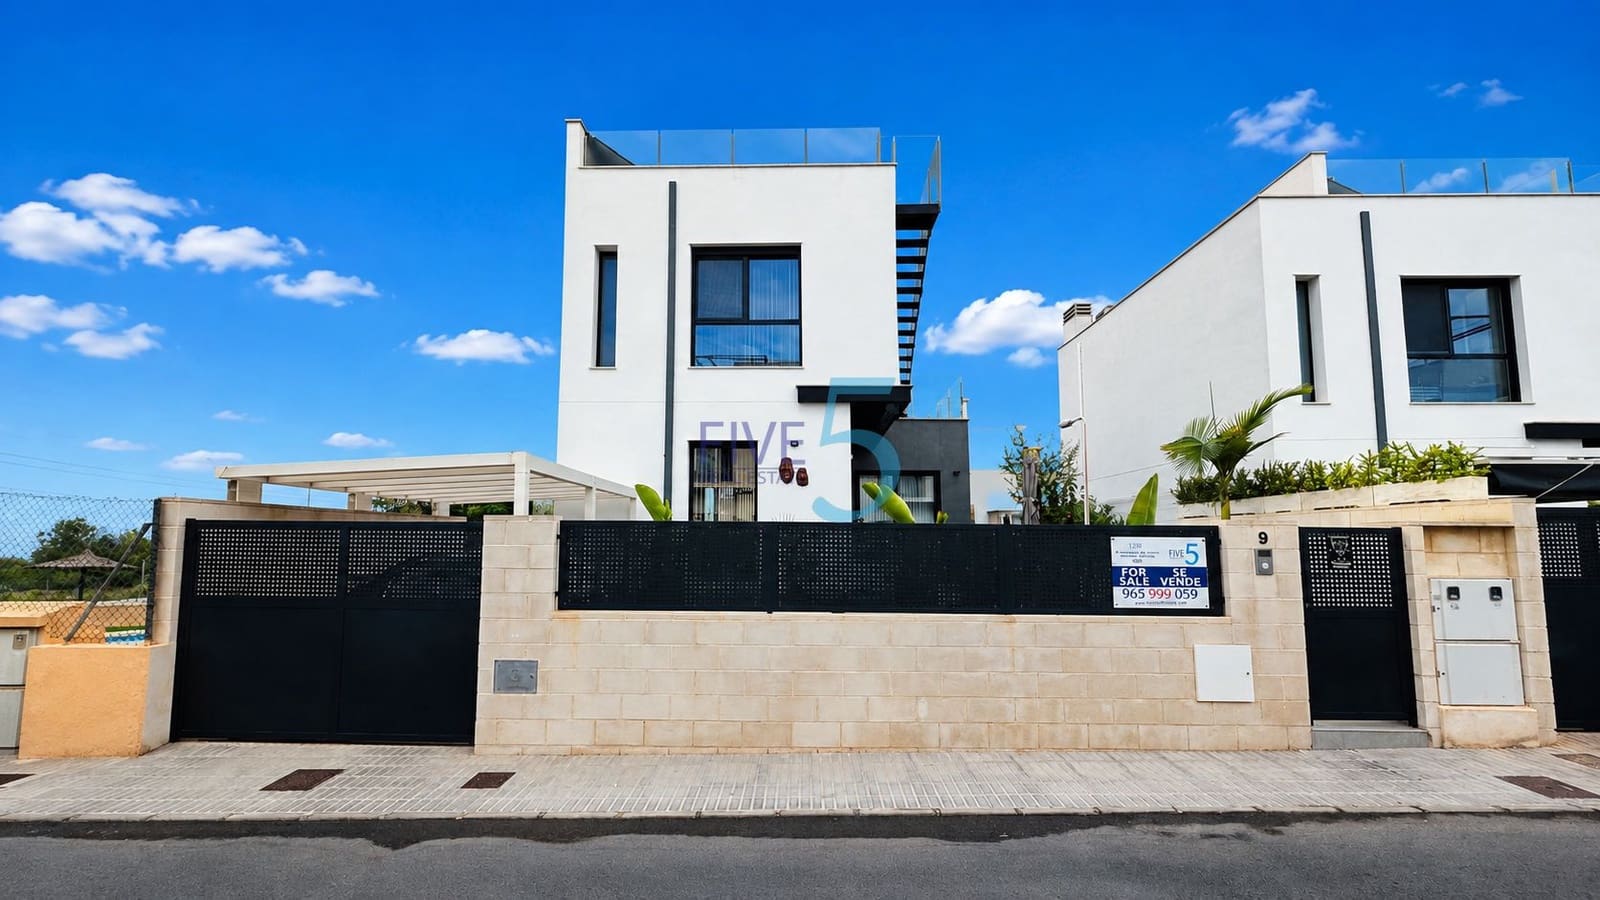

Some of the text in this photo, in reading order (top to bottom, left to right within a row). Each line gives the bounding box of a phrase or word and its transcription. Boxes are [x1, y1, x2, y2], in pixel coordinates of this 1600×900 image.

[1258, 531, 1269, 545] 9
[1168, 549, 1184, 558] FIVE
[1184, 543, 1199, 565] 5
[1121, 567, 1147, 577] FOR
[1172, 567, 1187, 578] SE
[1120, 577, 1150, 586] SALE
[1160, 577, 1201, 587] VENDE
[1122, 588, 1198, 600] 965 999 059
